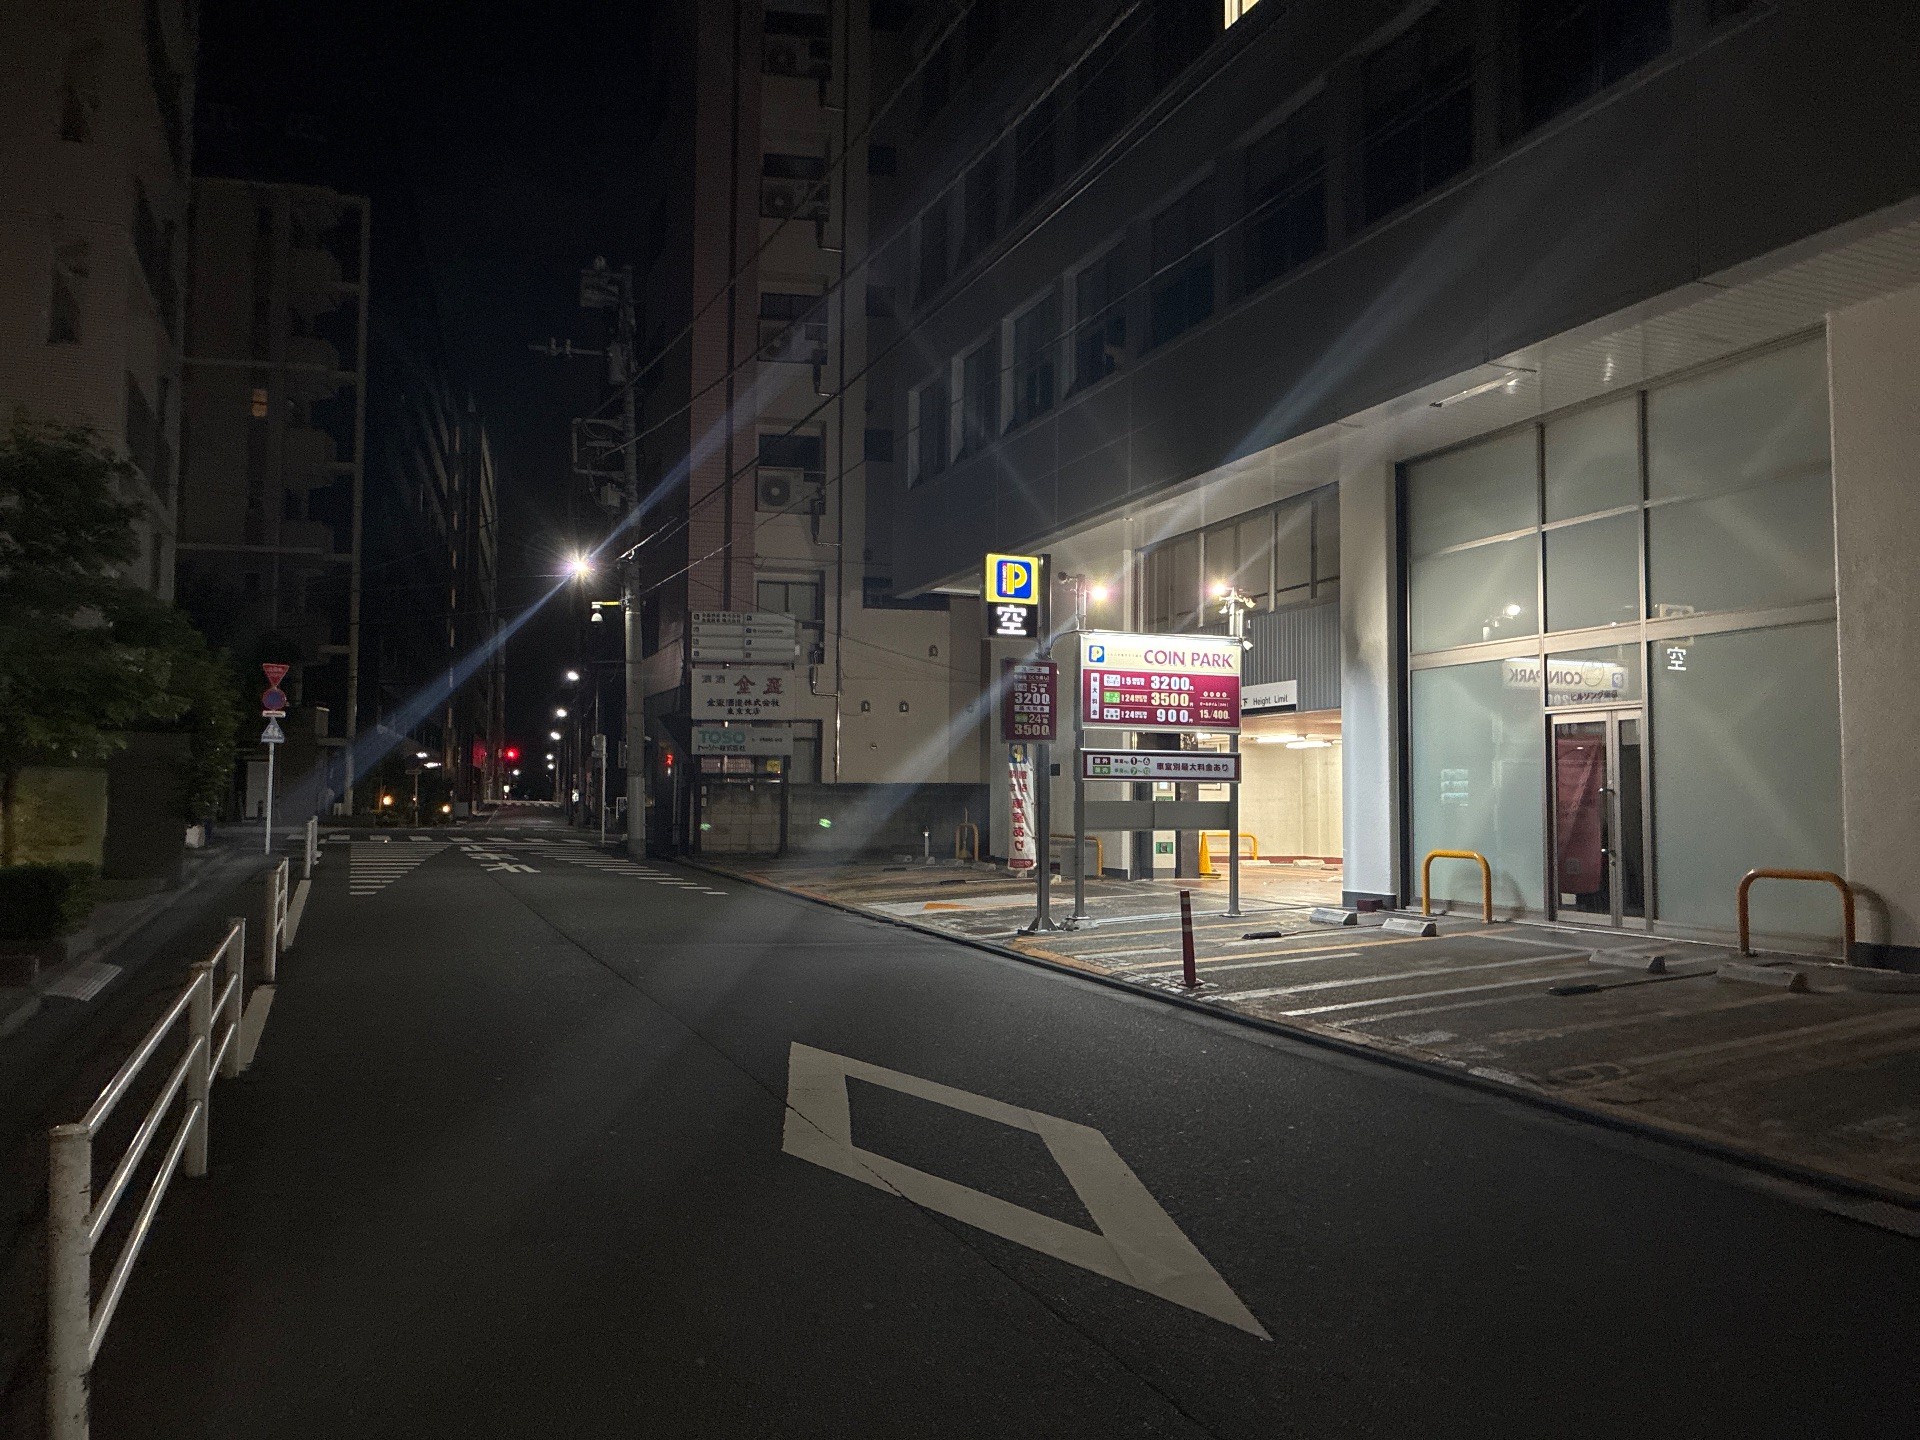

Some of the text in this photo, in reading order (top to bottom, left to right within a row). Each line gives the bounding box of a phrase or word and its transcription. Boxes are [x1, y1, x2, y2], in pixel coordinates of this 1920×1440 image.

[996, 604, 1028, 636] 空
[1143, 649, 1234, 669] COIN PARK
[1253, 697, 1271, 707] Height
[1274, 694, 1288, 704] Limit
[698, 730, 746, 744] TOSO
